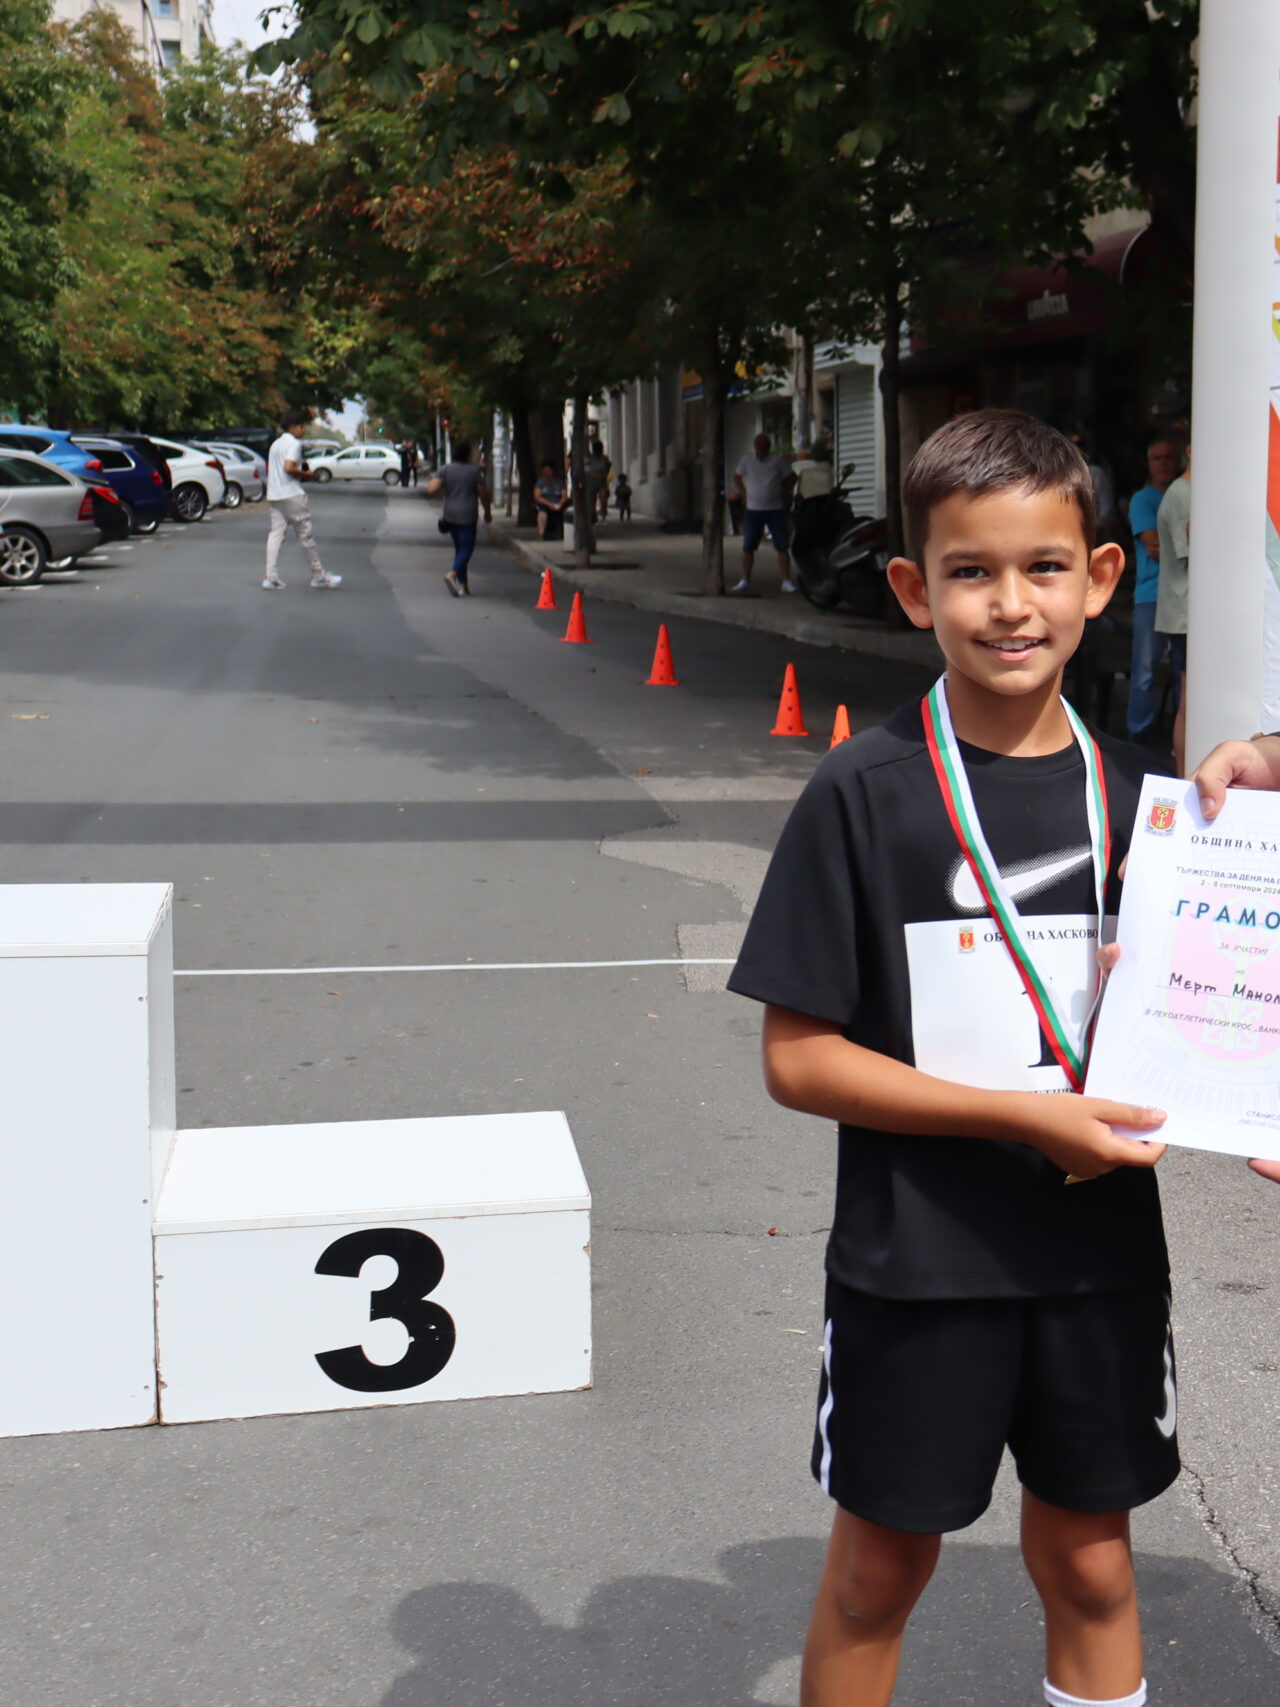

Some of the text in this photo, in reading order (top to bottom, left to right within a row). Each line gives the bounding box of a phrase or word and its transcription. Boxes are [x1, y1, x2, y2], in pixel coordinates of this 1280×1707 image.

[1190, 834, 1253, 850] ОБЩИНА
[1175, 866, 1225, 879] ТЪРЖЕСТВА
[1226, 872, 1238, 880] ЗА
[1238, 873, 1262, 883] ДЕНЯ
[1263, 876, 1275, 884] НА
[1219, 884, 1262, 894] септември
[983, 929, 1099, 943] ОБНА ХАСКОВО
[1218, 942, 1270, 956] ЗА УЧАСТИЕ
[1152, 1009, 1230, 1027] ЛЕКОАТЛЕТИЧЕСКИ
[1231, 1022, 1253, 1032] КРОС
[315, 1228, 456, 1392] 3
